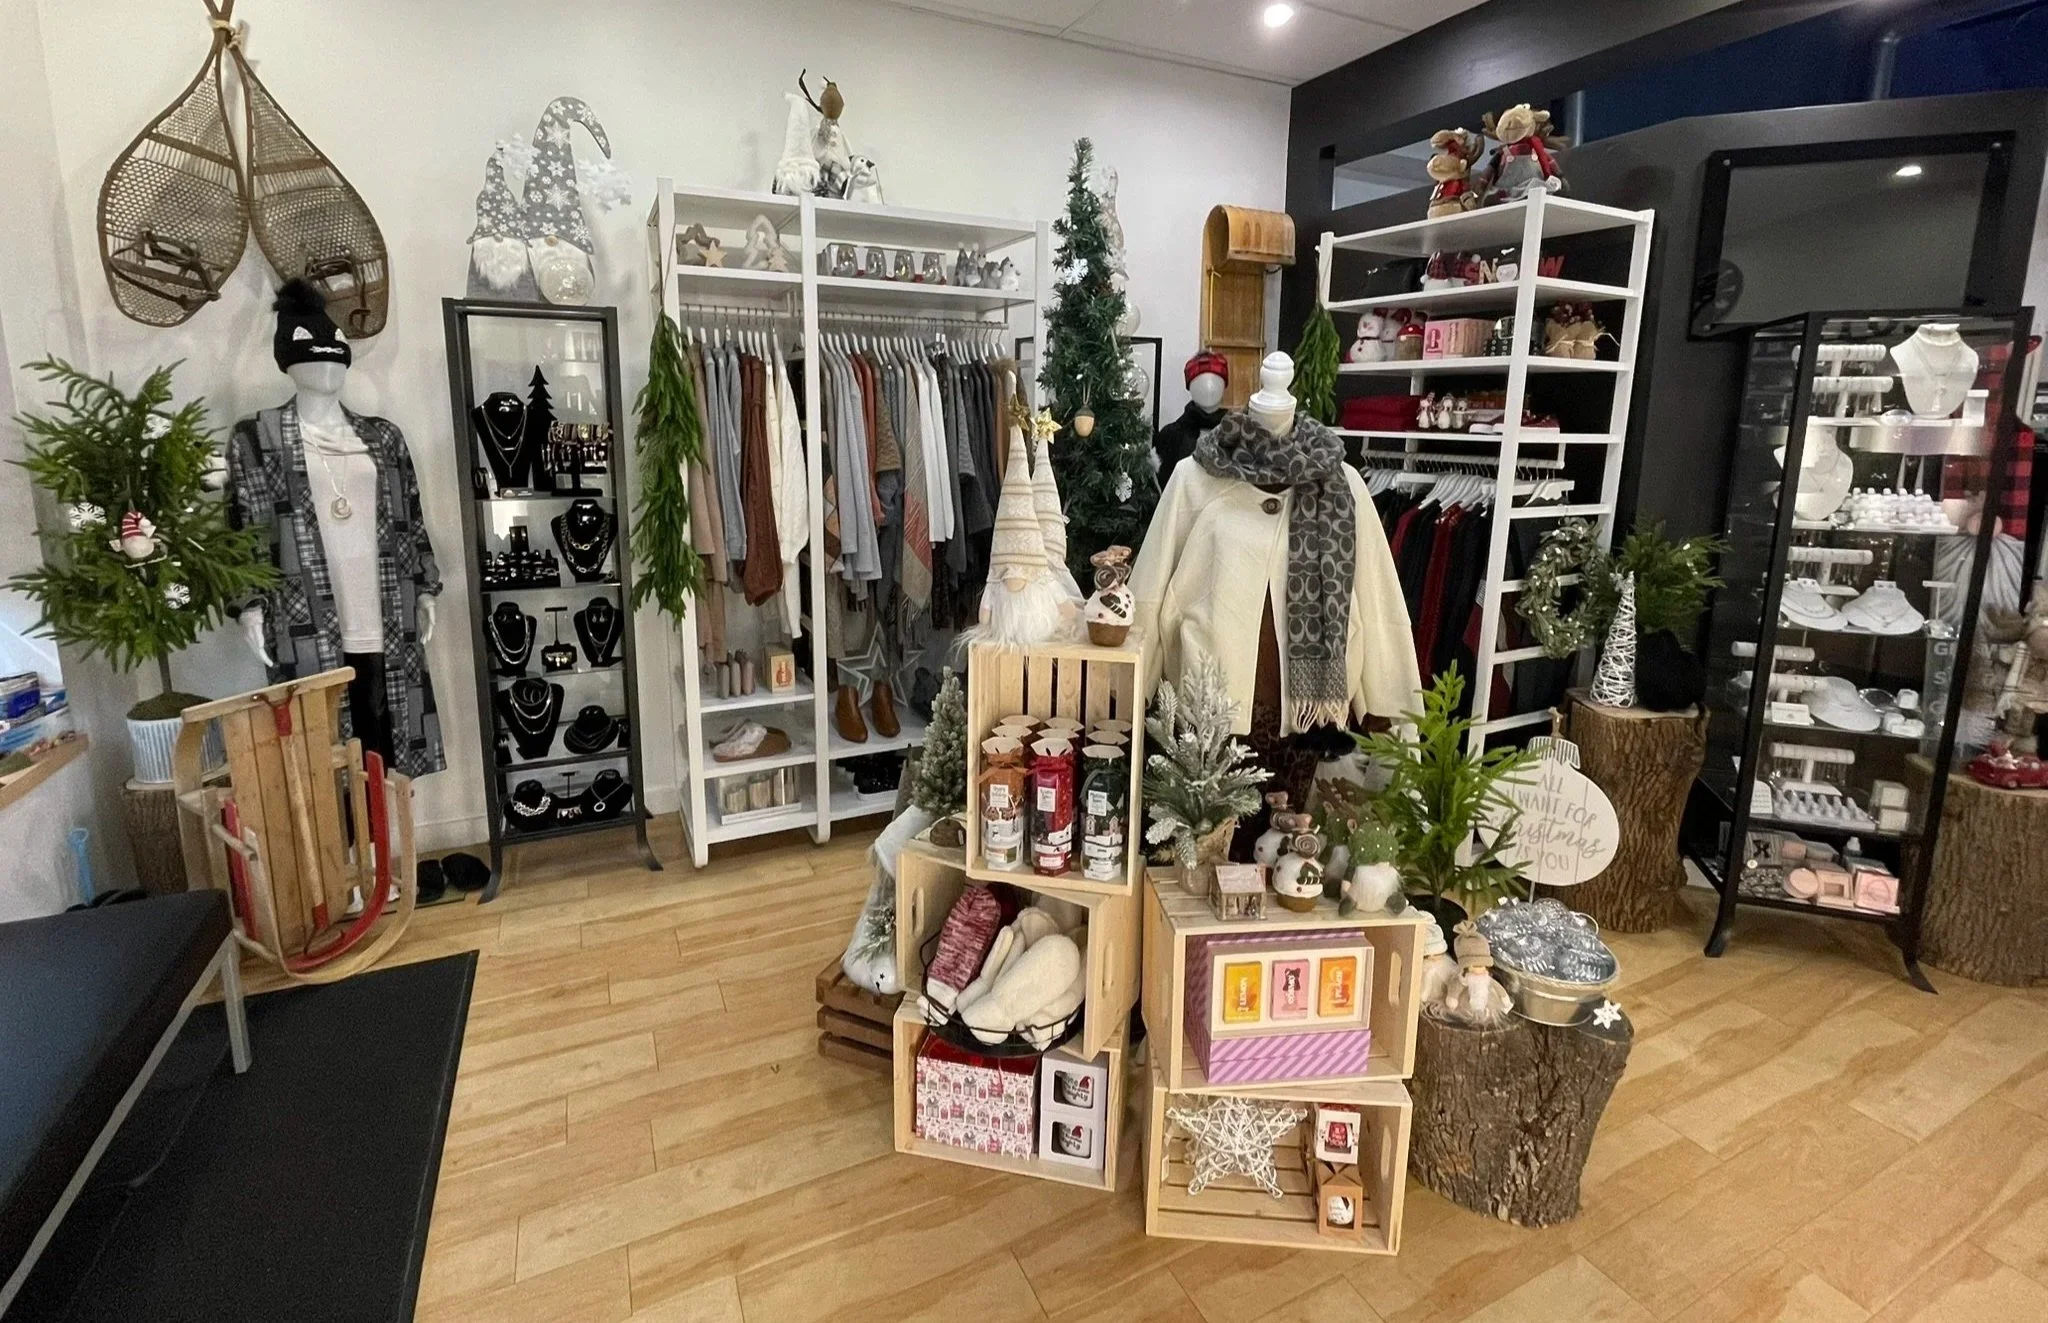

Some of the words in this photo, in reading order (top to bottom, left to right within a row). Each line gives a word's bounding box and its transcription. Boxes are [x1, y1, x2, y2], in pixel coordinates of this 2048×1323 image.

[1540, 773, 1564, 794] ALL
[1518, 790, 1561, 815] WANT
[1564, 801, 1597, 829] FOR
[1536, 848, 1570, 872] YOU
